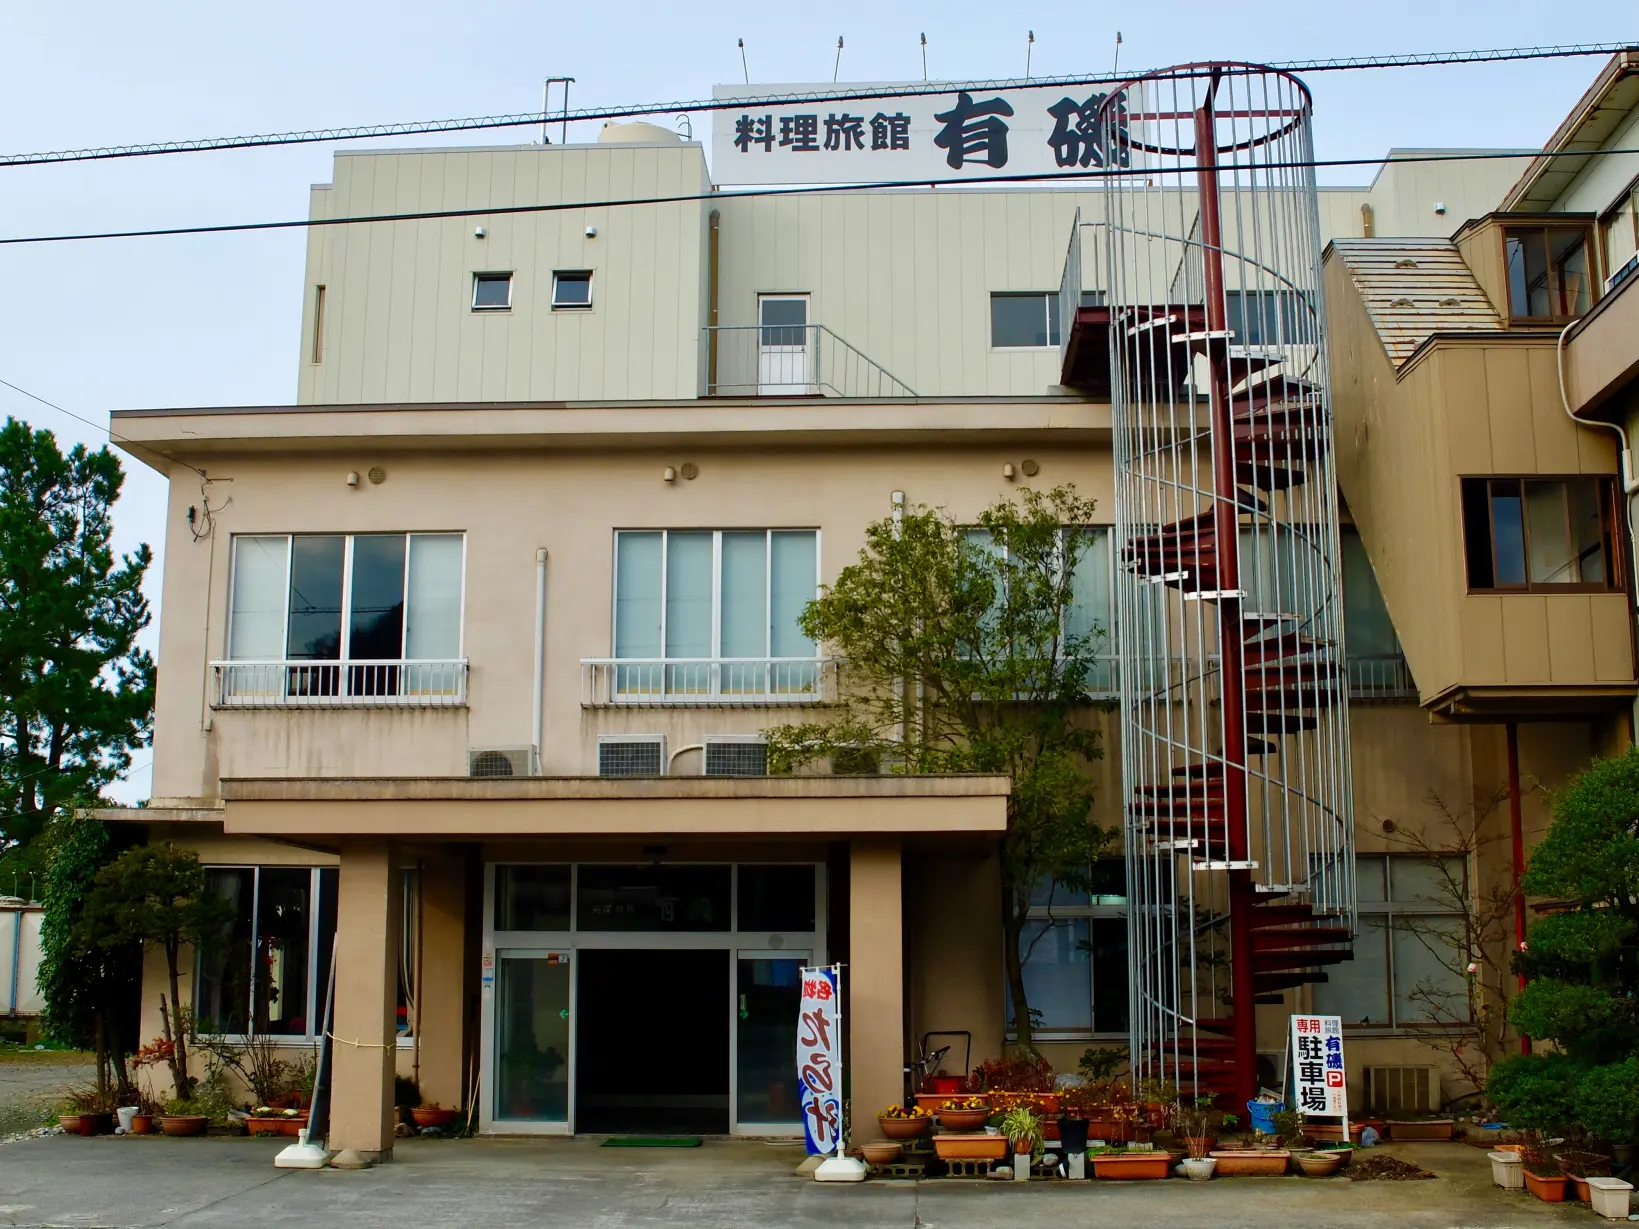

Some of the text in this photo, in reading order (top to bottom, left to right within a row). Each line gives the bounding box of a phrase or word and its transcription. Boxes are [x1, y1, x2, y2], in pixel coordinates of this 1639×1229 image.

[734, 91, 1130, 169] 料理旅館 有磯
[1296, 1018, 1321, 1034] 専用
[1324, 1035, 1343, 1070] 有磯
[1297, 1035, 1327, 1112] 駐車場
[1328, 1072, 1342, 1086] P
